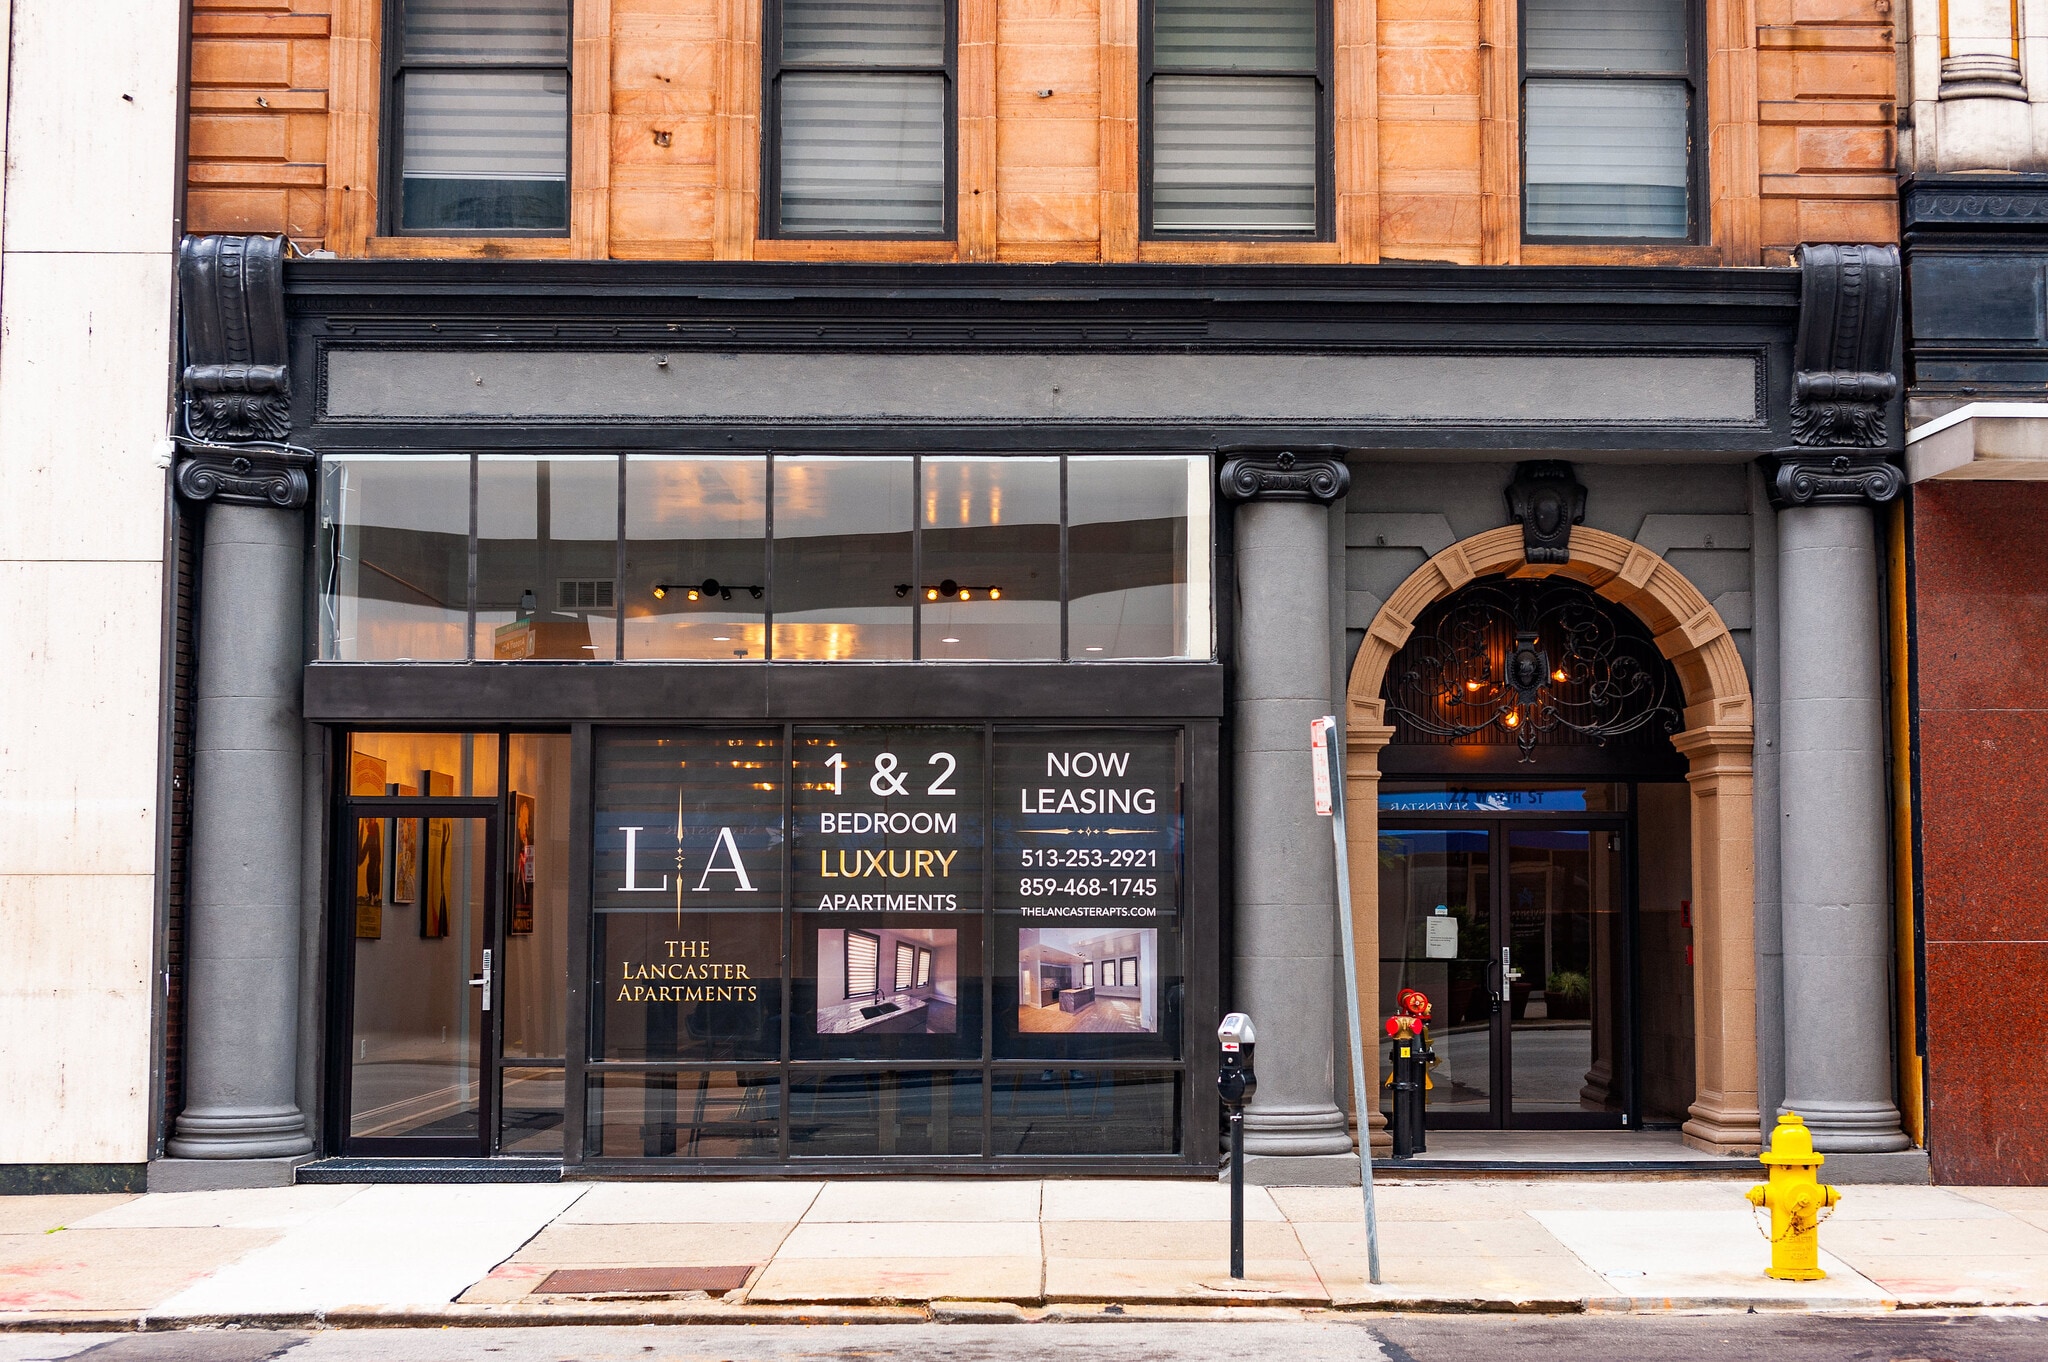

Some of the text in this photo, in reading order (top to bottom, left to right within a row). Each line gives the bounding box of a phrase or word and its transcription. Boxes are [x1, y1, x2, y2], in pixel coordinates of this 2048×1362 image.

[823, 752, 957, 797] 1 & 2
[1047, 751, 1130, 778] NOW
[1021, 788, 1157, 815] LEASING
[1449, 787, 1470, 804] 22
[820, 812, 957, 834] BEDROOM
[617, 826, 759, 892] L A
[821, 849, 958, 878] LUXURY
[1021, 848, 1157, 867] 513-253-2921
[1019, 877, 1157, 897] 859-468-1745
[817, 893, 957, 912] APARTMENTS
[1020, 906, 1156, 917] THELANCASTERAPTS.COM
[664, 940, 710, 959] THE
[622, 962, 750, 980] LANCASTER
[616, 983, 757, 1003] APARTMENTS
